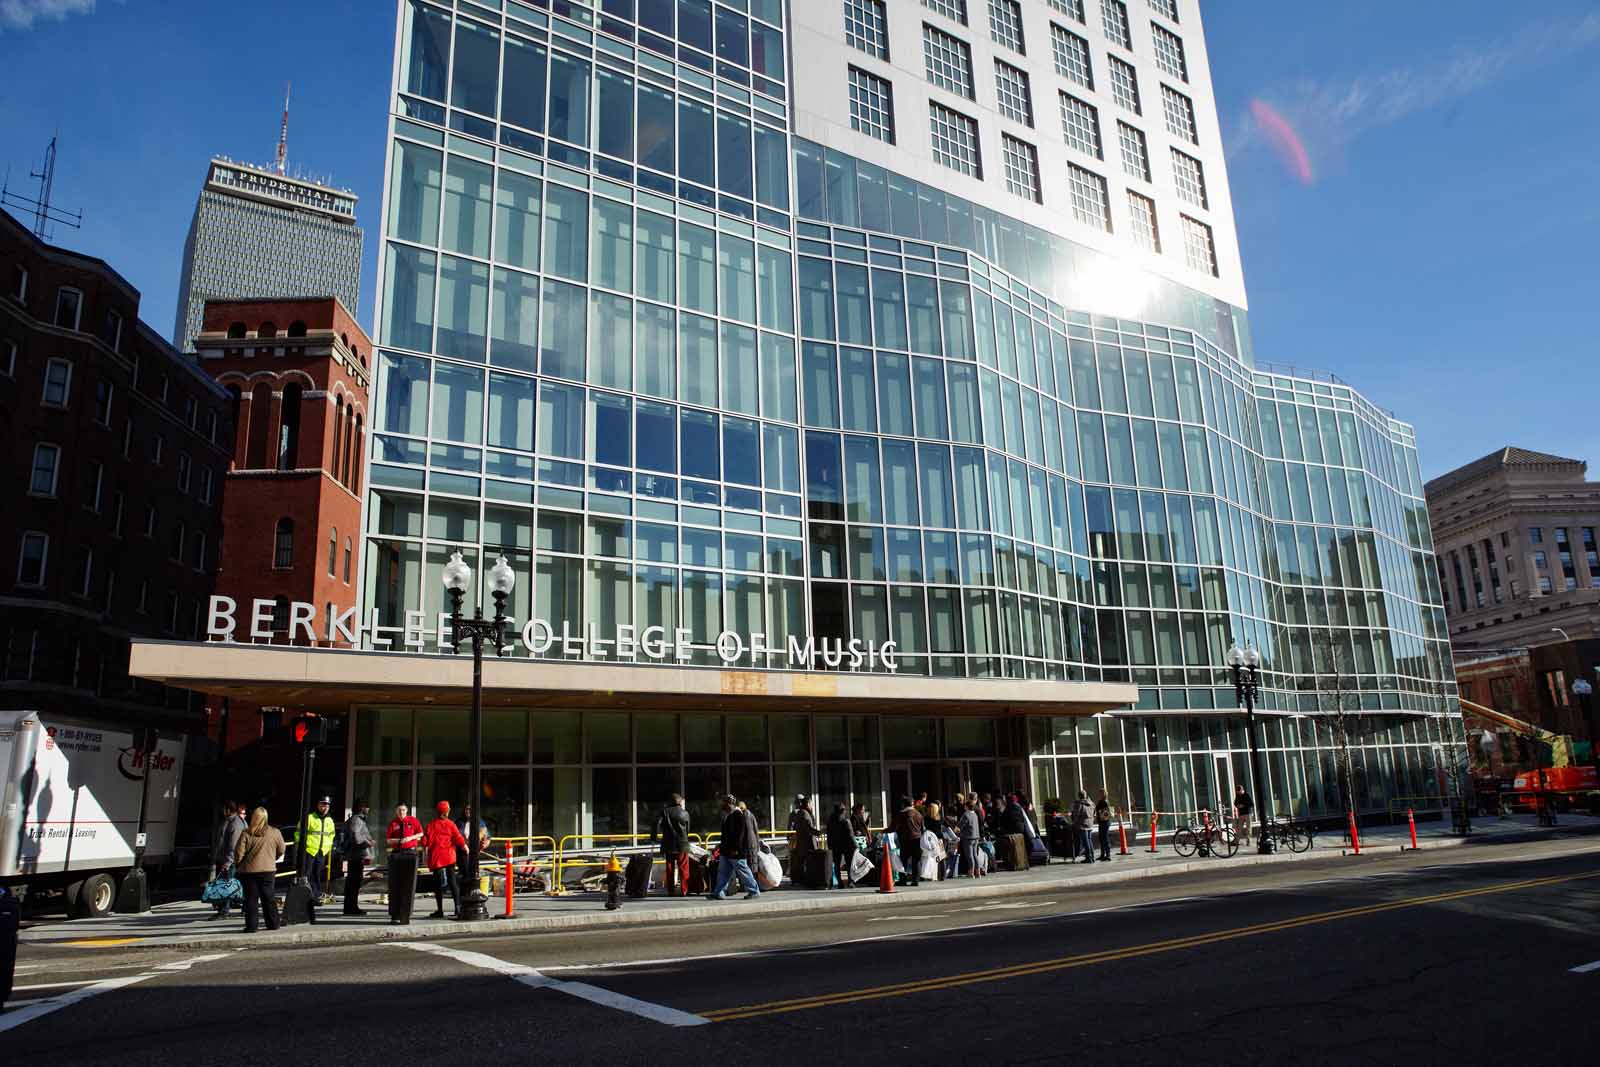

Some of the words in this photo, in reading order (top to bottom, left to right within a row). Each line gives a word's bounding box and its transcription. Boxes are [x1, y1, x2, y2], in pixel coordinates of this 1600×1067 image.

[239, 172, 332, 202] PRUDENTIAL
[206, 595, 453, 648] BERKLEE
[716, 630, 766, 663] OF
[787, 634, 898, 669] MUSIC
[48, 828, 69, 838] Rental
[75, 828, 97, 840] Leasing
